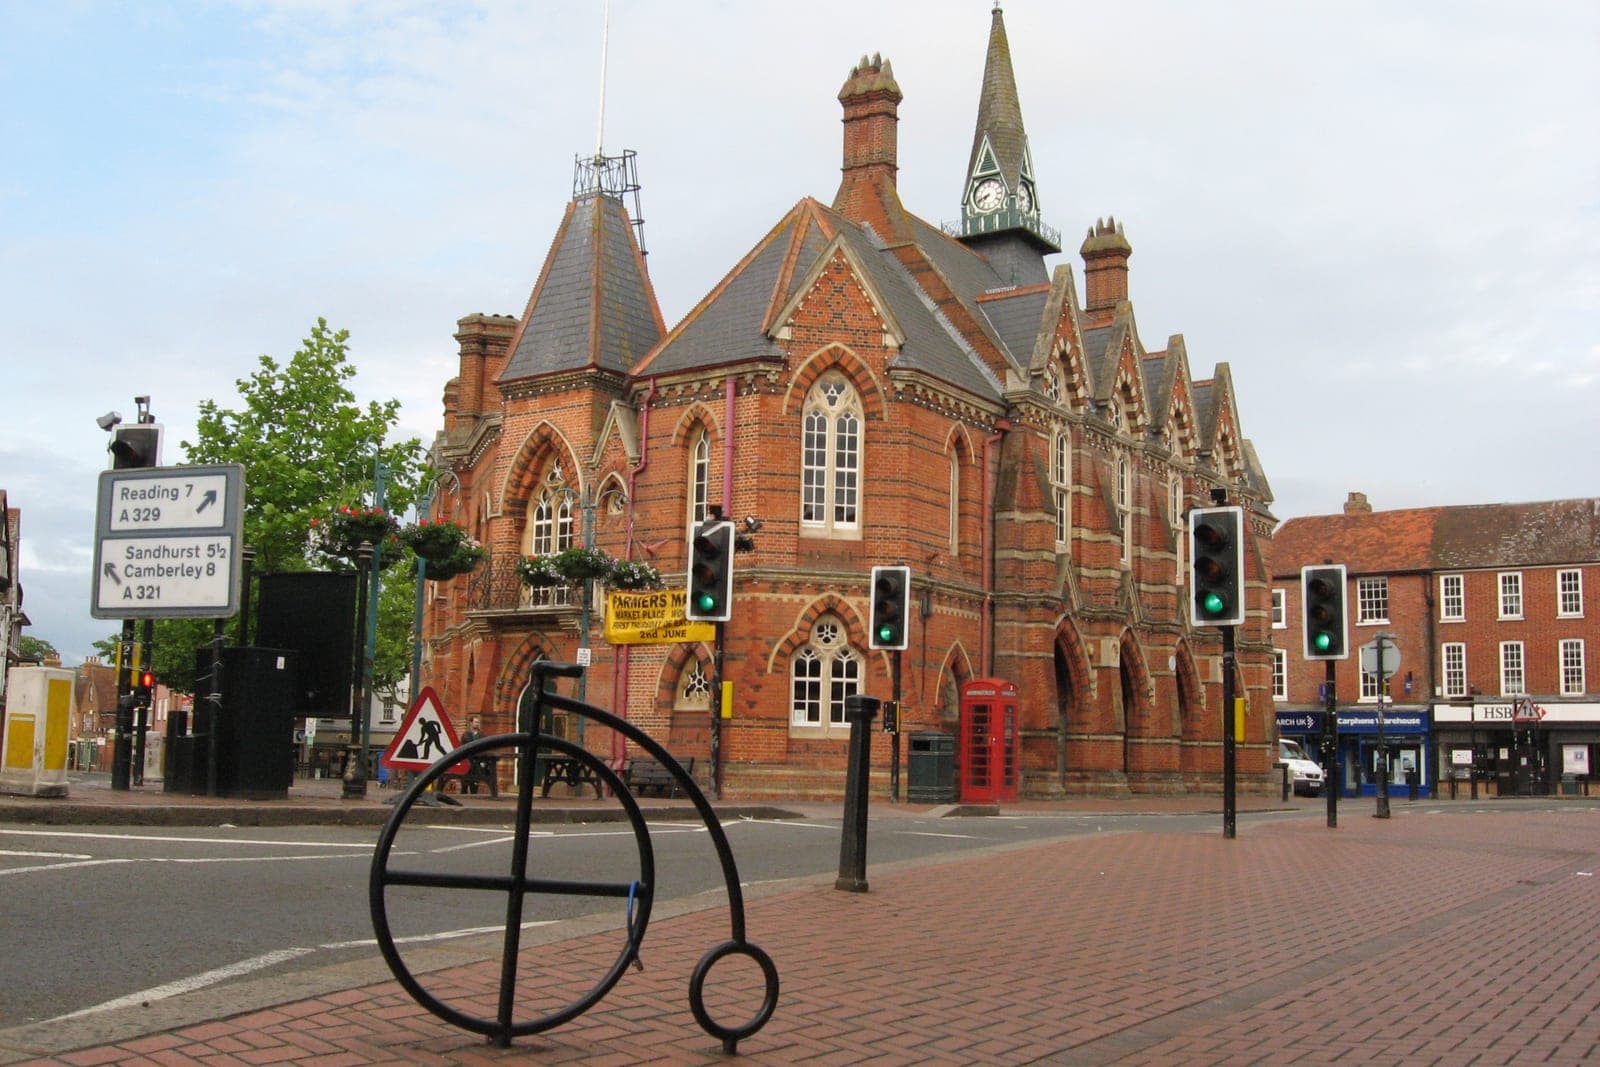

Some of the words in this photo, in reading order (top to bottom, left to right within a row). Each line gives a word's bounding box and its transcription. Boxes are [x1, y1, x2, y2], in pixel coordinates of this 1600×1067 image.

[121, 485, 178, 501] Reading
[185, 484, 193, 498] 7
[126, 545, 200, 560] Sandhurst
[124, 564, 203, 579] Camberley
[206, 562, 216, 576] 8
[613, 594, 667, 608] FARMERS
[642, 610, 665, 619] PLACE
[662, 630, 686, 638] JUNE
[1337, 718, 1374, 726] Carphone
